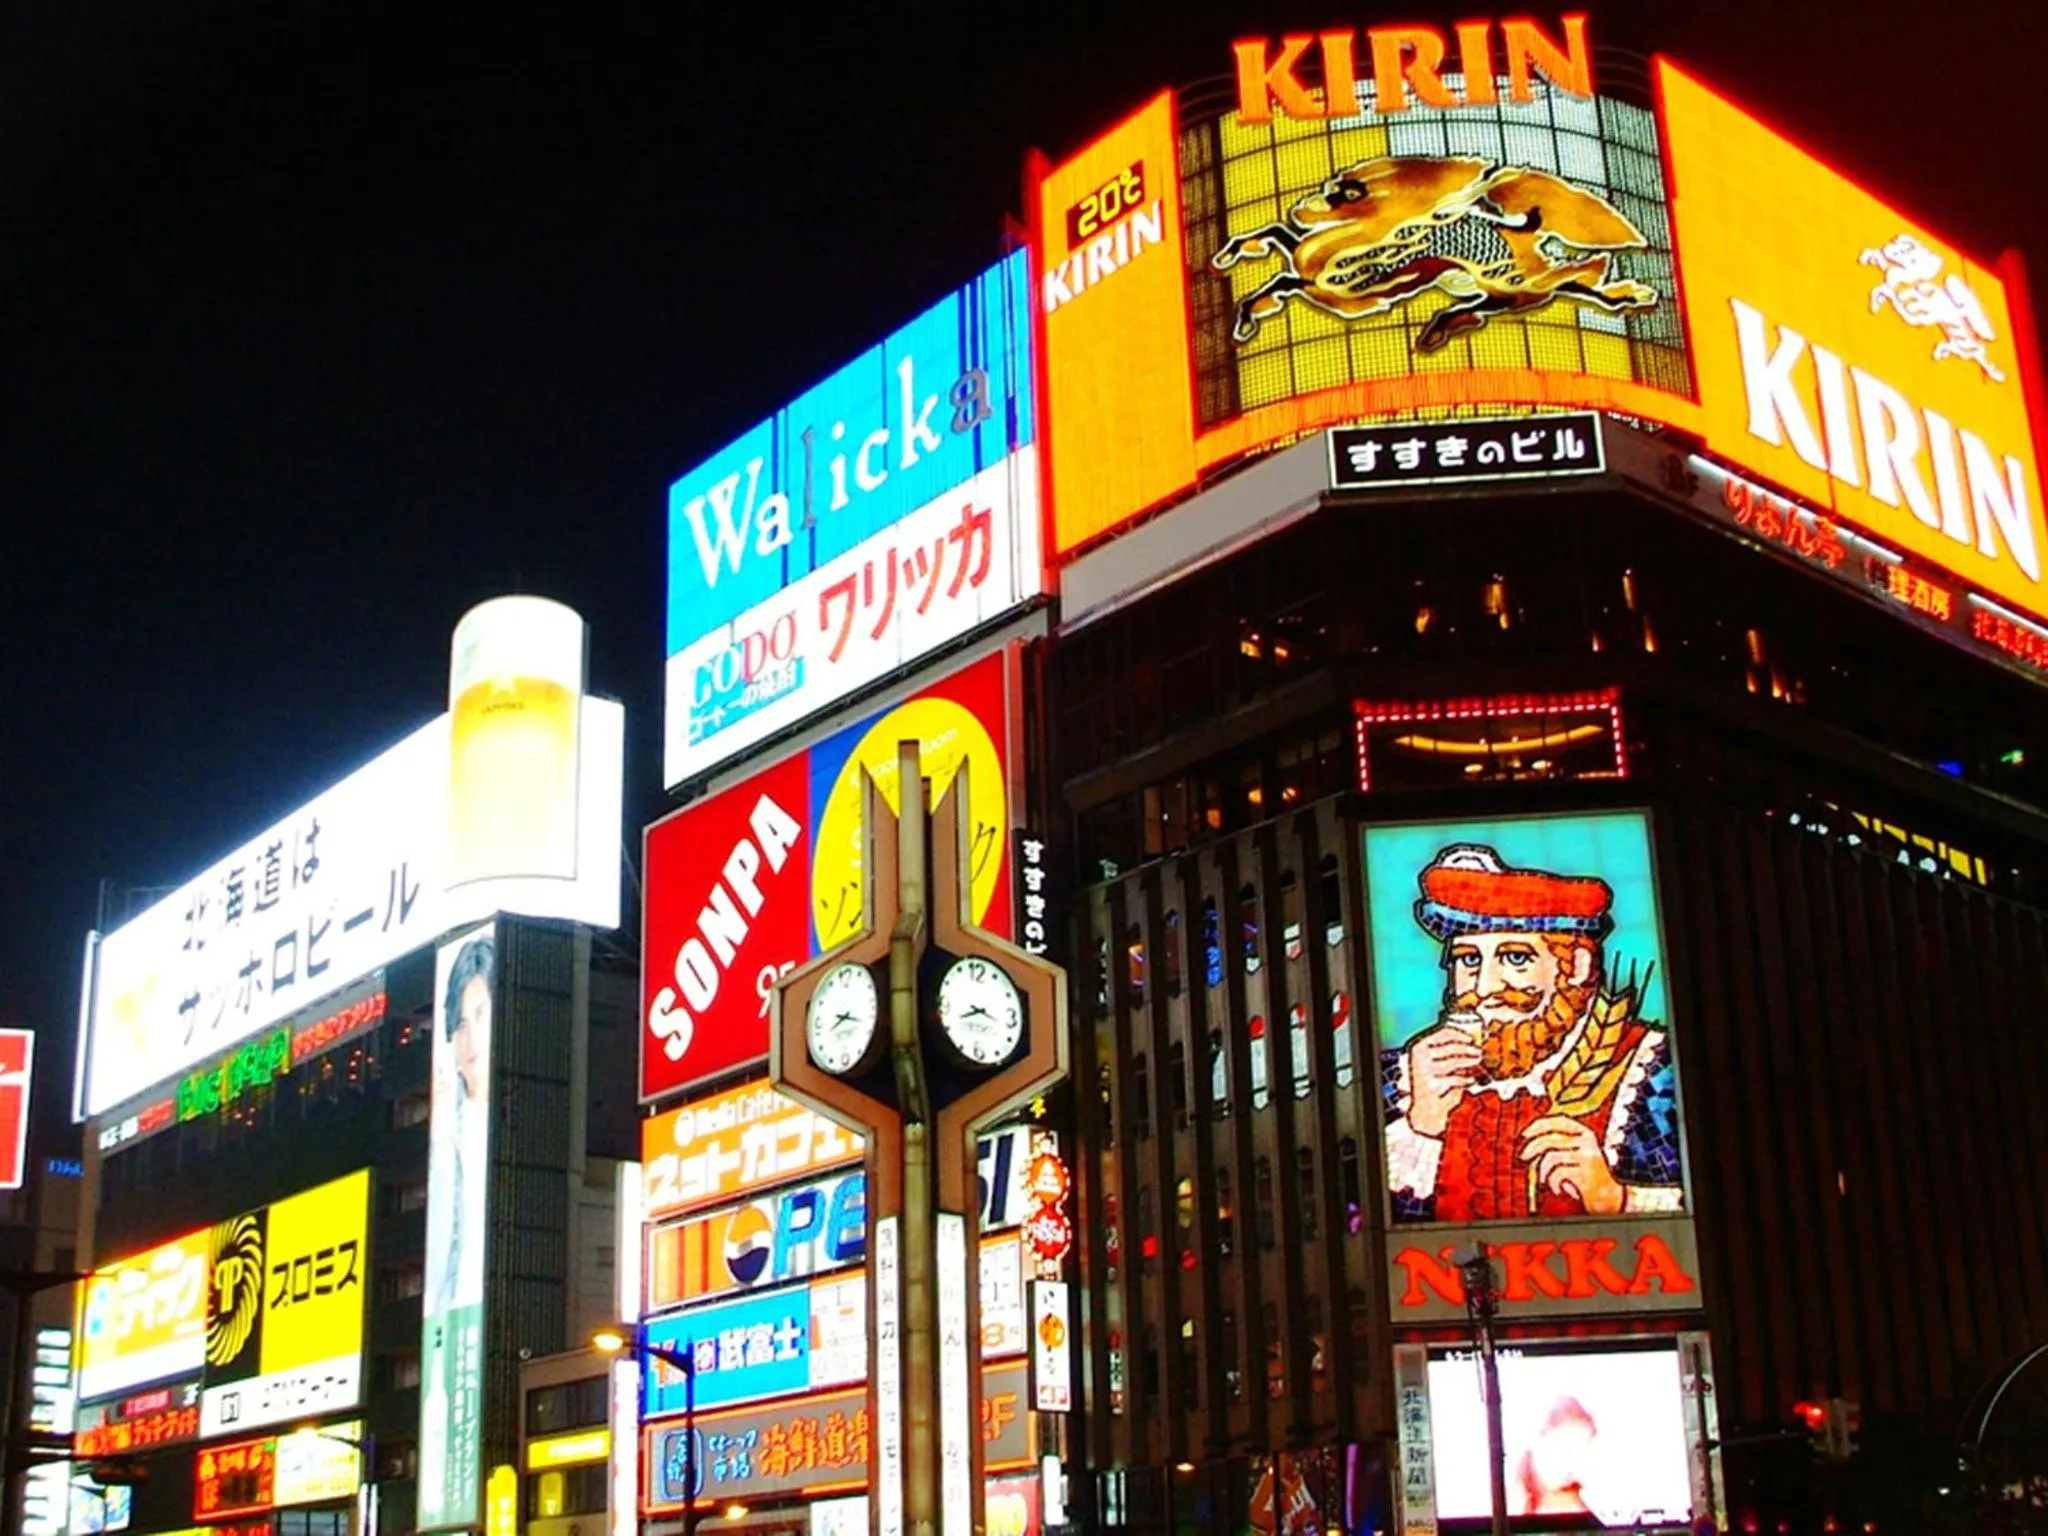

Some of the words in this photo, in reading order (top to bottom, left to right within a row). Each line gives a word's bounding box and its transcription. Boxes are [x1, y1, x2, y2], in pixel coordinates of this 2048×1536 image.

[1232, 14, 1593, 126] KIRIN
[1042, 200, 1164, 314] KIRIN
[683, 355, 993, 589] Walicka
[1347, 427, 1585, 474] すすきのビル
[1729, 297, 2041, 584] KIRIN
[818, 502, 993, 664] ワリッカ
[182, 816, 322, 951] 北海道は
[650, 794, 801, 1061] SONPA
[968, 962, 986, 984] 12
[1005, 1008, 1018, 1029] 3
[648, 1111, 866, 1206] ネットカフェ
[270, 1239, 359, 1310] プロミス
[1394, 1233, 1696, 1307] NKKA
